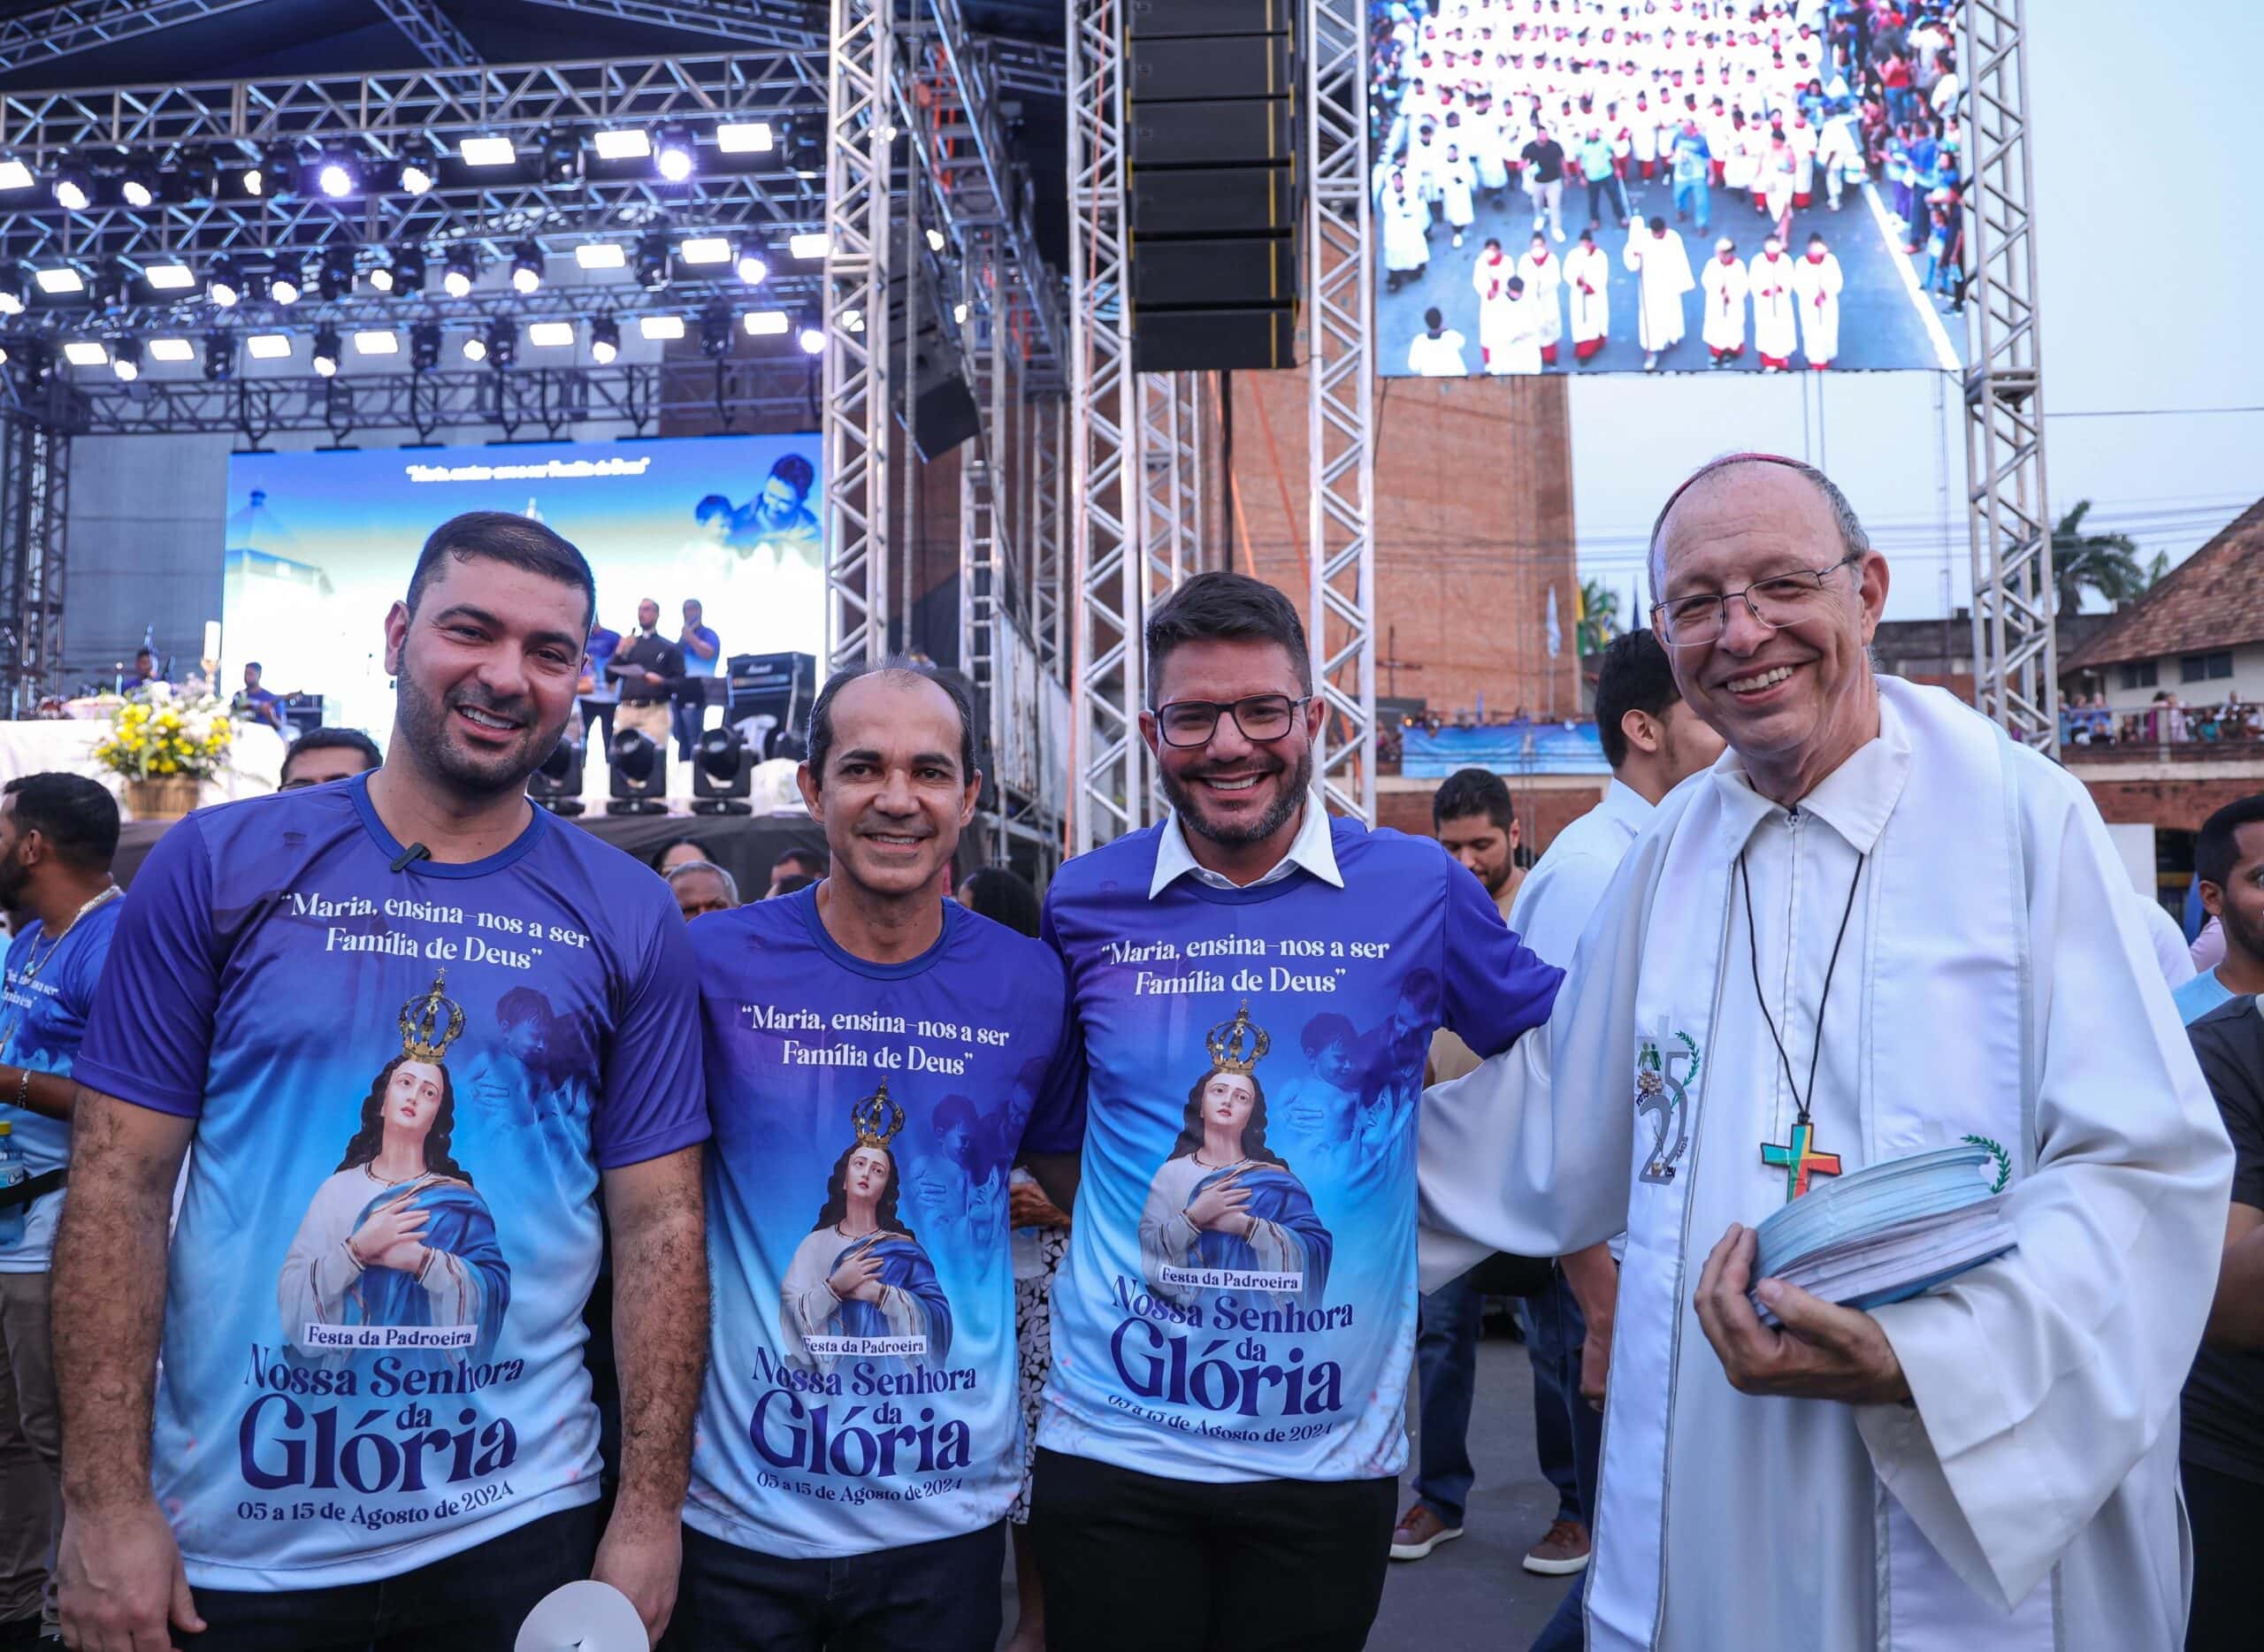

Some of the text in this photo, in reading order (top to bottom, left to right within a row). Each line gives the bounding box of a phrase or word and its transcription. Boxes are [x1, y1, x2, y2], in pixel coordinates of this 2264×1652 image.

[281, 892, 590, 949] “Maria, ensina-nos a ser
[325, 928, 543, 969] Família de Deus”
[1101, 933, 1391, 965] “Maria, ensina-nos a ser
[1135, 967, 1346, 996] Família de Deus”
[741, 1005, 1010, 1047] “Maria, ensina-nos a ser
[783, 1039, 974, 1075] Família de Deus”
[1162, 1266, 1298, 1289] Festa da Padroeira
[1112, 1274, 1353, 1334] Nossa Senhora
[307, 1326, 472, 1347] Festa da Padroeira
[803, 1336, 924, 1354] Festa da Padroeira
[1235, 1336, 1266, 1362] da
[243, 1342, 524, 1398] Nossa Senhora
[751, 1346, 977, 1396] Nossa Senhora
[1110, 1316, 1344, 1417] Glória
[395, 1401, 433, 1430] da
[873, 1401, 903, 1425] da
[1168, 1416, 1190, 1431] de
[1194, 1419, 1259, 1442] Agosto
[1264, 1427, 1286, 1442] de
[239, 1393, 517, 1494] Glória
[749, 1388, 973, 1477] Glória
[237, 1480, 515, 1531] 05 a 15 de Agosto de 2024
[757, 1472, 962, 1505] 05 a 15 de Agosto de 2024
